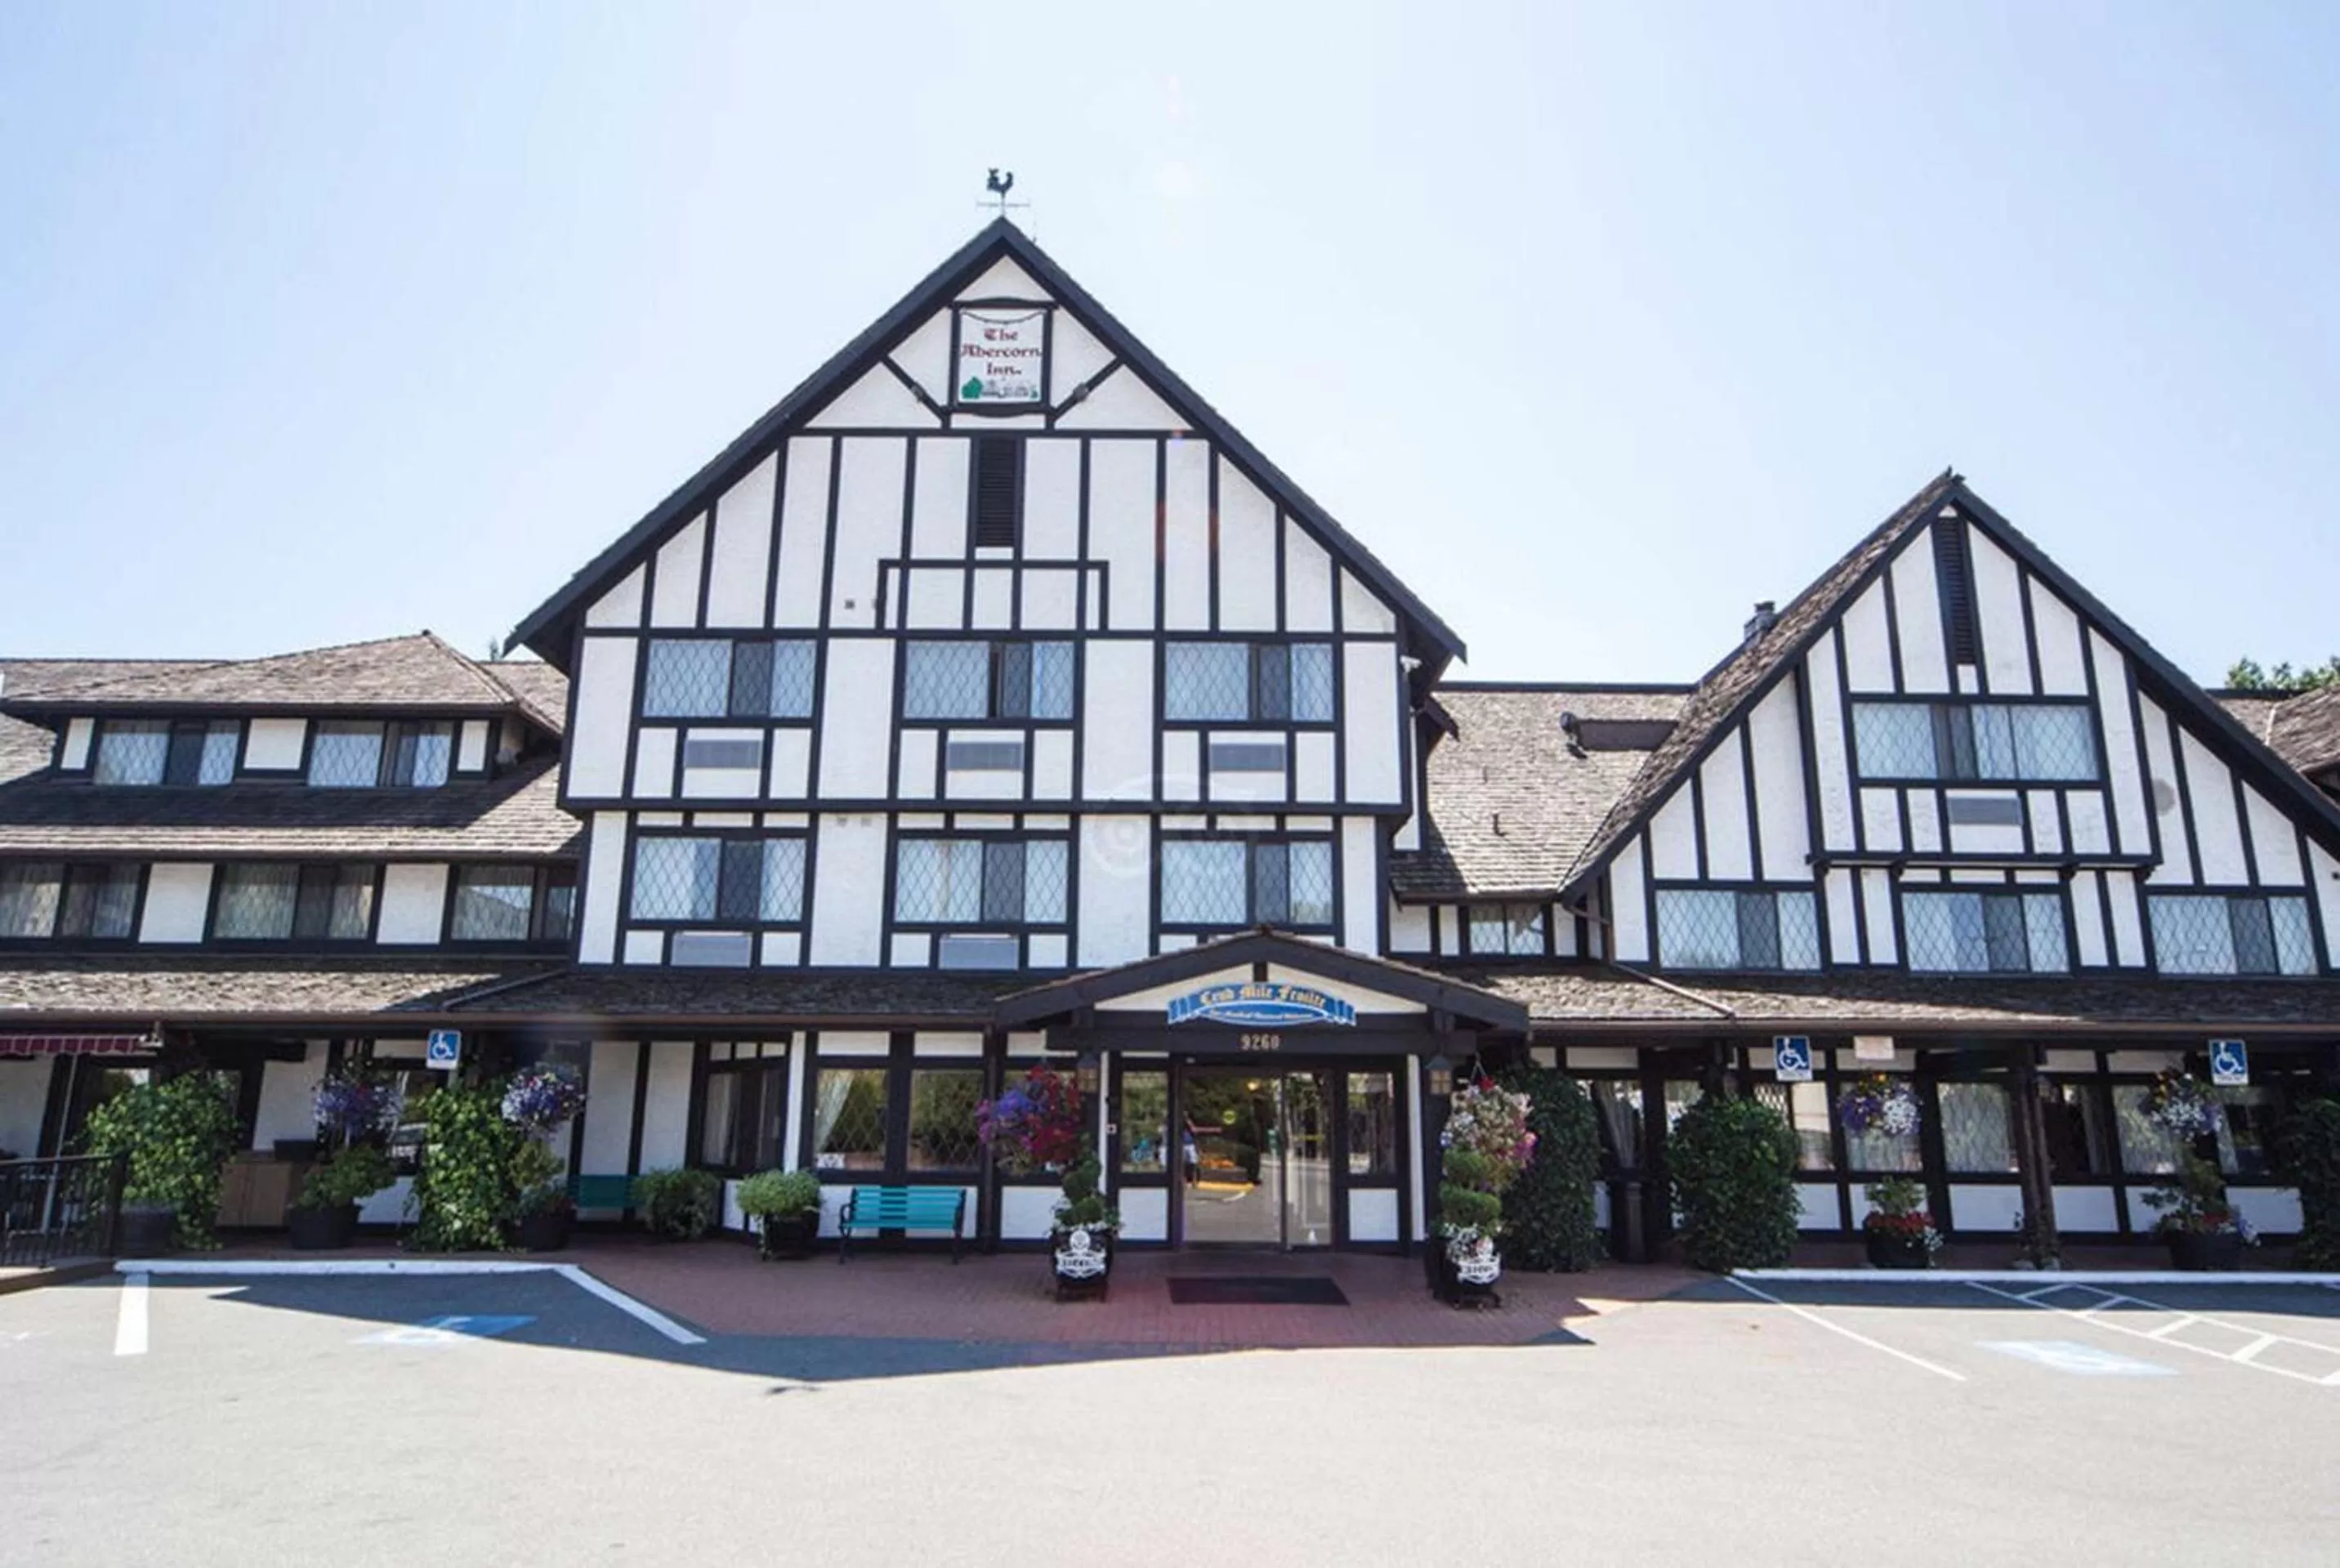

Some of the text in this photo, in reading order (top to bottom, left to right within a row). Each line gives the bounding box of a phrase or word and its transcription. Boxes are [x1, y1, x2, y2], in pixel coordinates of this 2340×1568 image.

[983, 328, 1018, 341] The
[961, 344, 1042, 358] Abercorn
[1239, 1034, 1281, 1050] 9260
